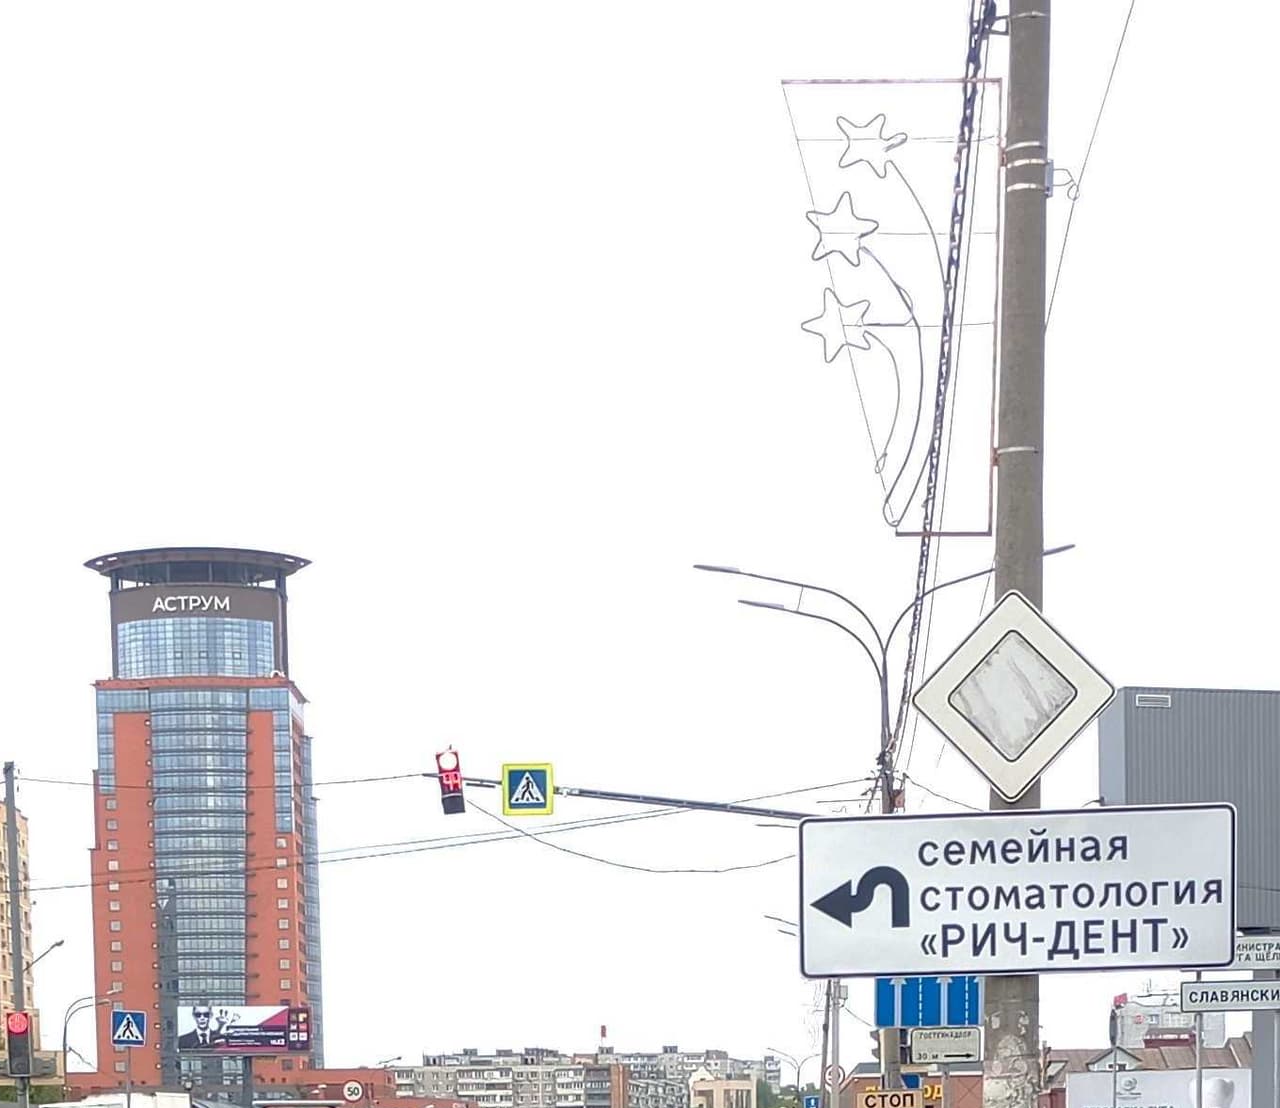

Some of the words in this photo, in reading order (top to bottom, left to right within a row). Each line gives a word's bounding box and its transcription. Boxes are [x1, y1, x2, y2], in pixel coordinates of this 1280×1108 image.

[151, 594, 231, 612] АСТРУМ
[918, 828, 1129, 867] семейная
[920, 878, 1223, 912] стоматология
[920, 918, 1189, 961] «РИЧ-ДЕНТ»
[347, 1086, 360, 1097] 50
[864, 1093, 915, 1108] СТОП
